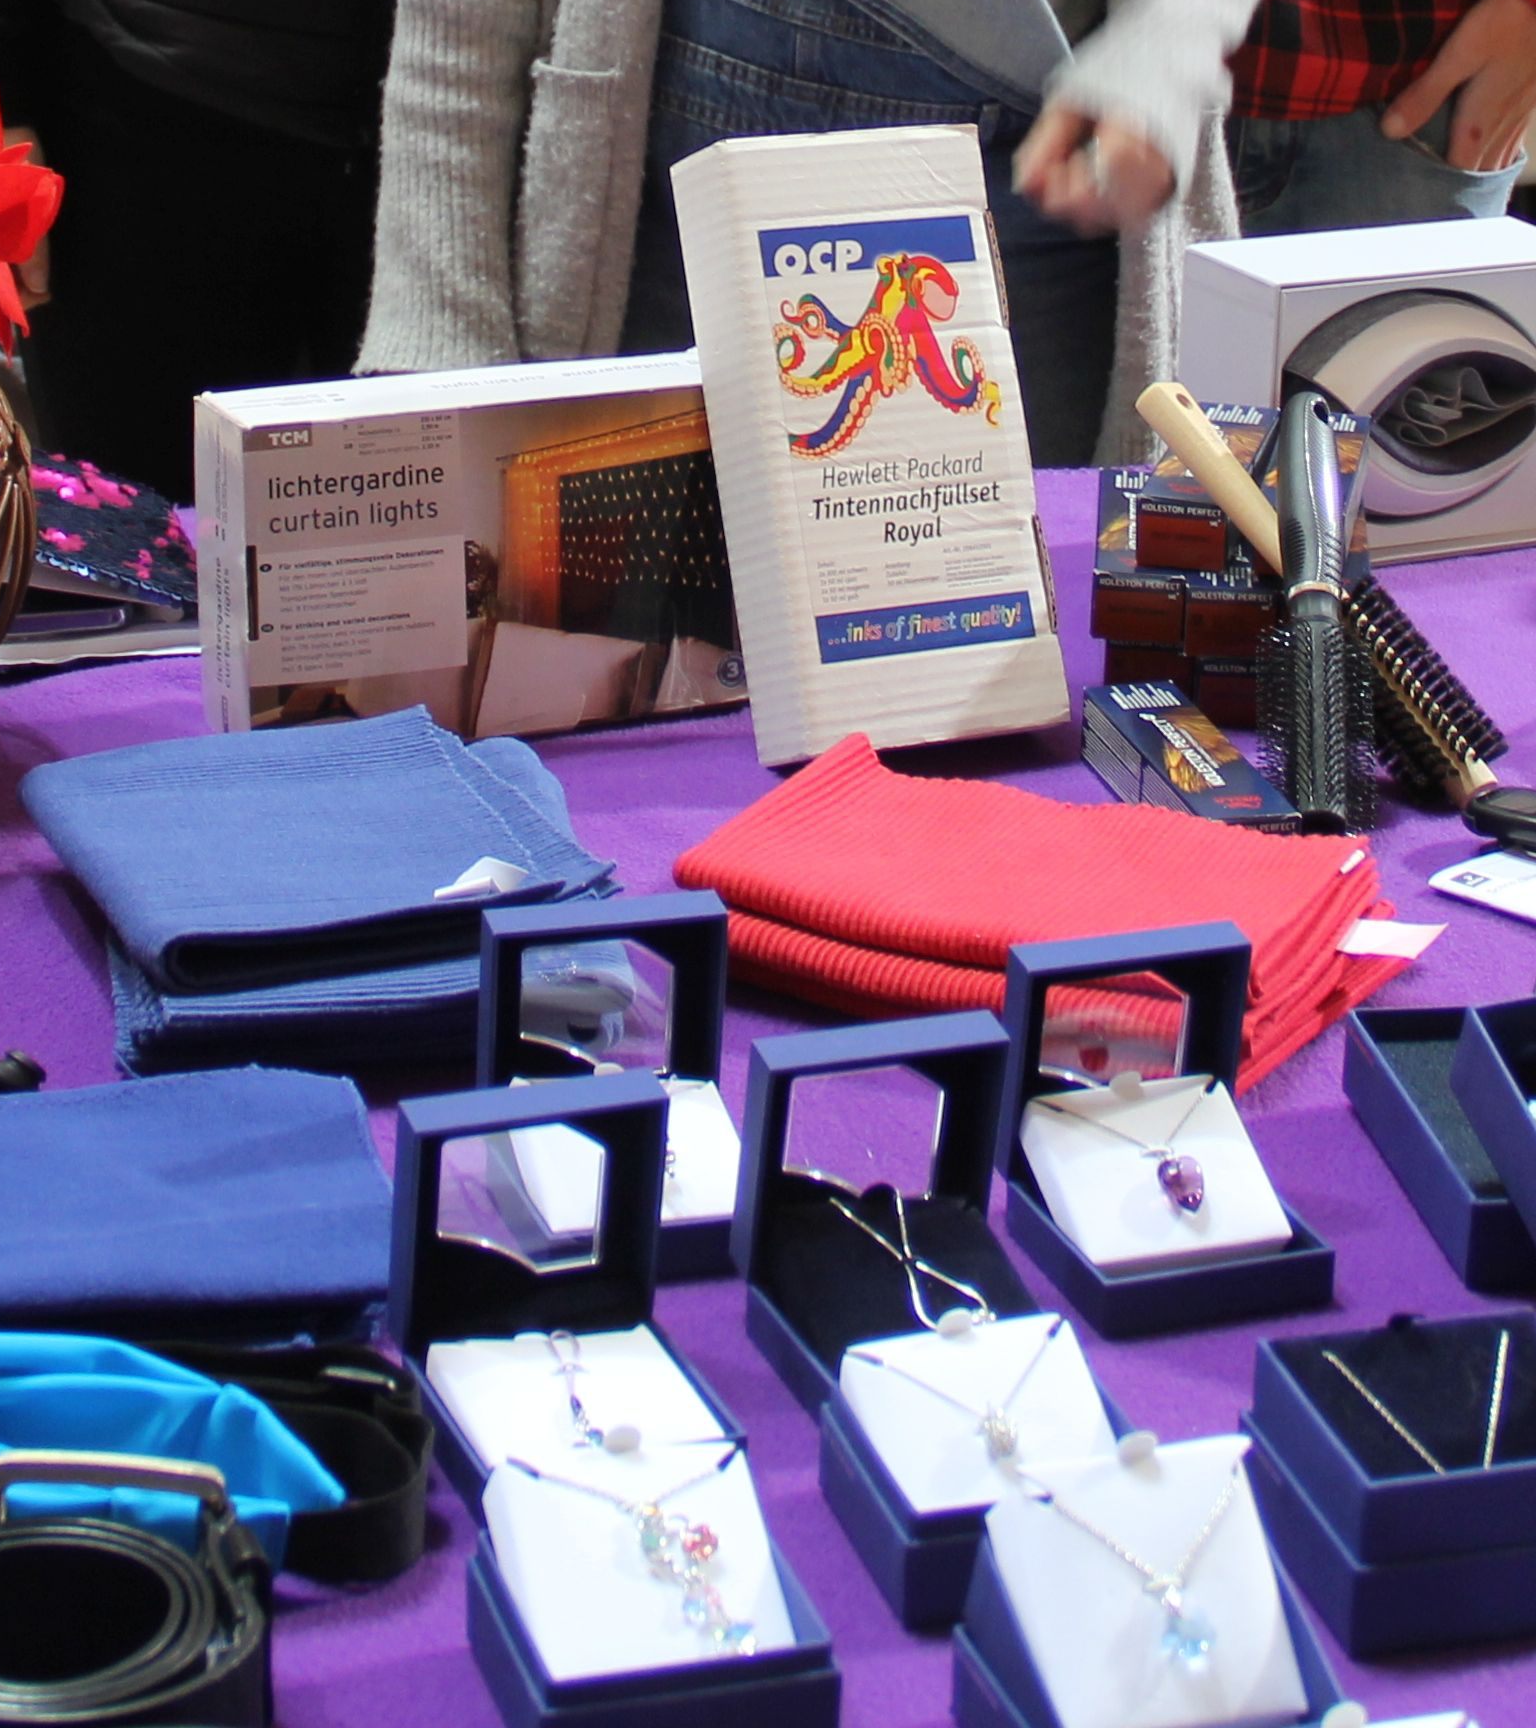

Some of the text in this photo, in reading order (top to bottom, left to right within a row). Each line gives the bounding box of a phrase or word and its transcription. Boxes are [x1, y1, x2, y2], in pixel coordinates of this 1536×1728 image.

[773, 239, 864, 277] OCP
[268, 430, 310, 446] TCM
[268, 464, 445, 500] lichtergardine
[821, 450, 984, 489] Hewlett Packard
[268, 499, 439, 534] curtain lights
[812, 480, 1001, 521] Tintennachfüllset
[1141, 503, 1222, 517] KOLESTON PERFECT
[884, 516, 943, 547] Royal
[1099, 577, 1181, 591] KOLESTON PERFECT
[1191, 590, 1236, 602] KOLESTON
[885, 615, 906, 641] of
[906, 611, 958, 641] finest
[960, 602, 1022, 633] quality!
[1259, 822, 1297, 833] PERFECT
